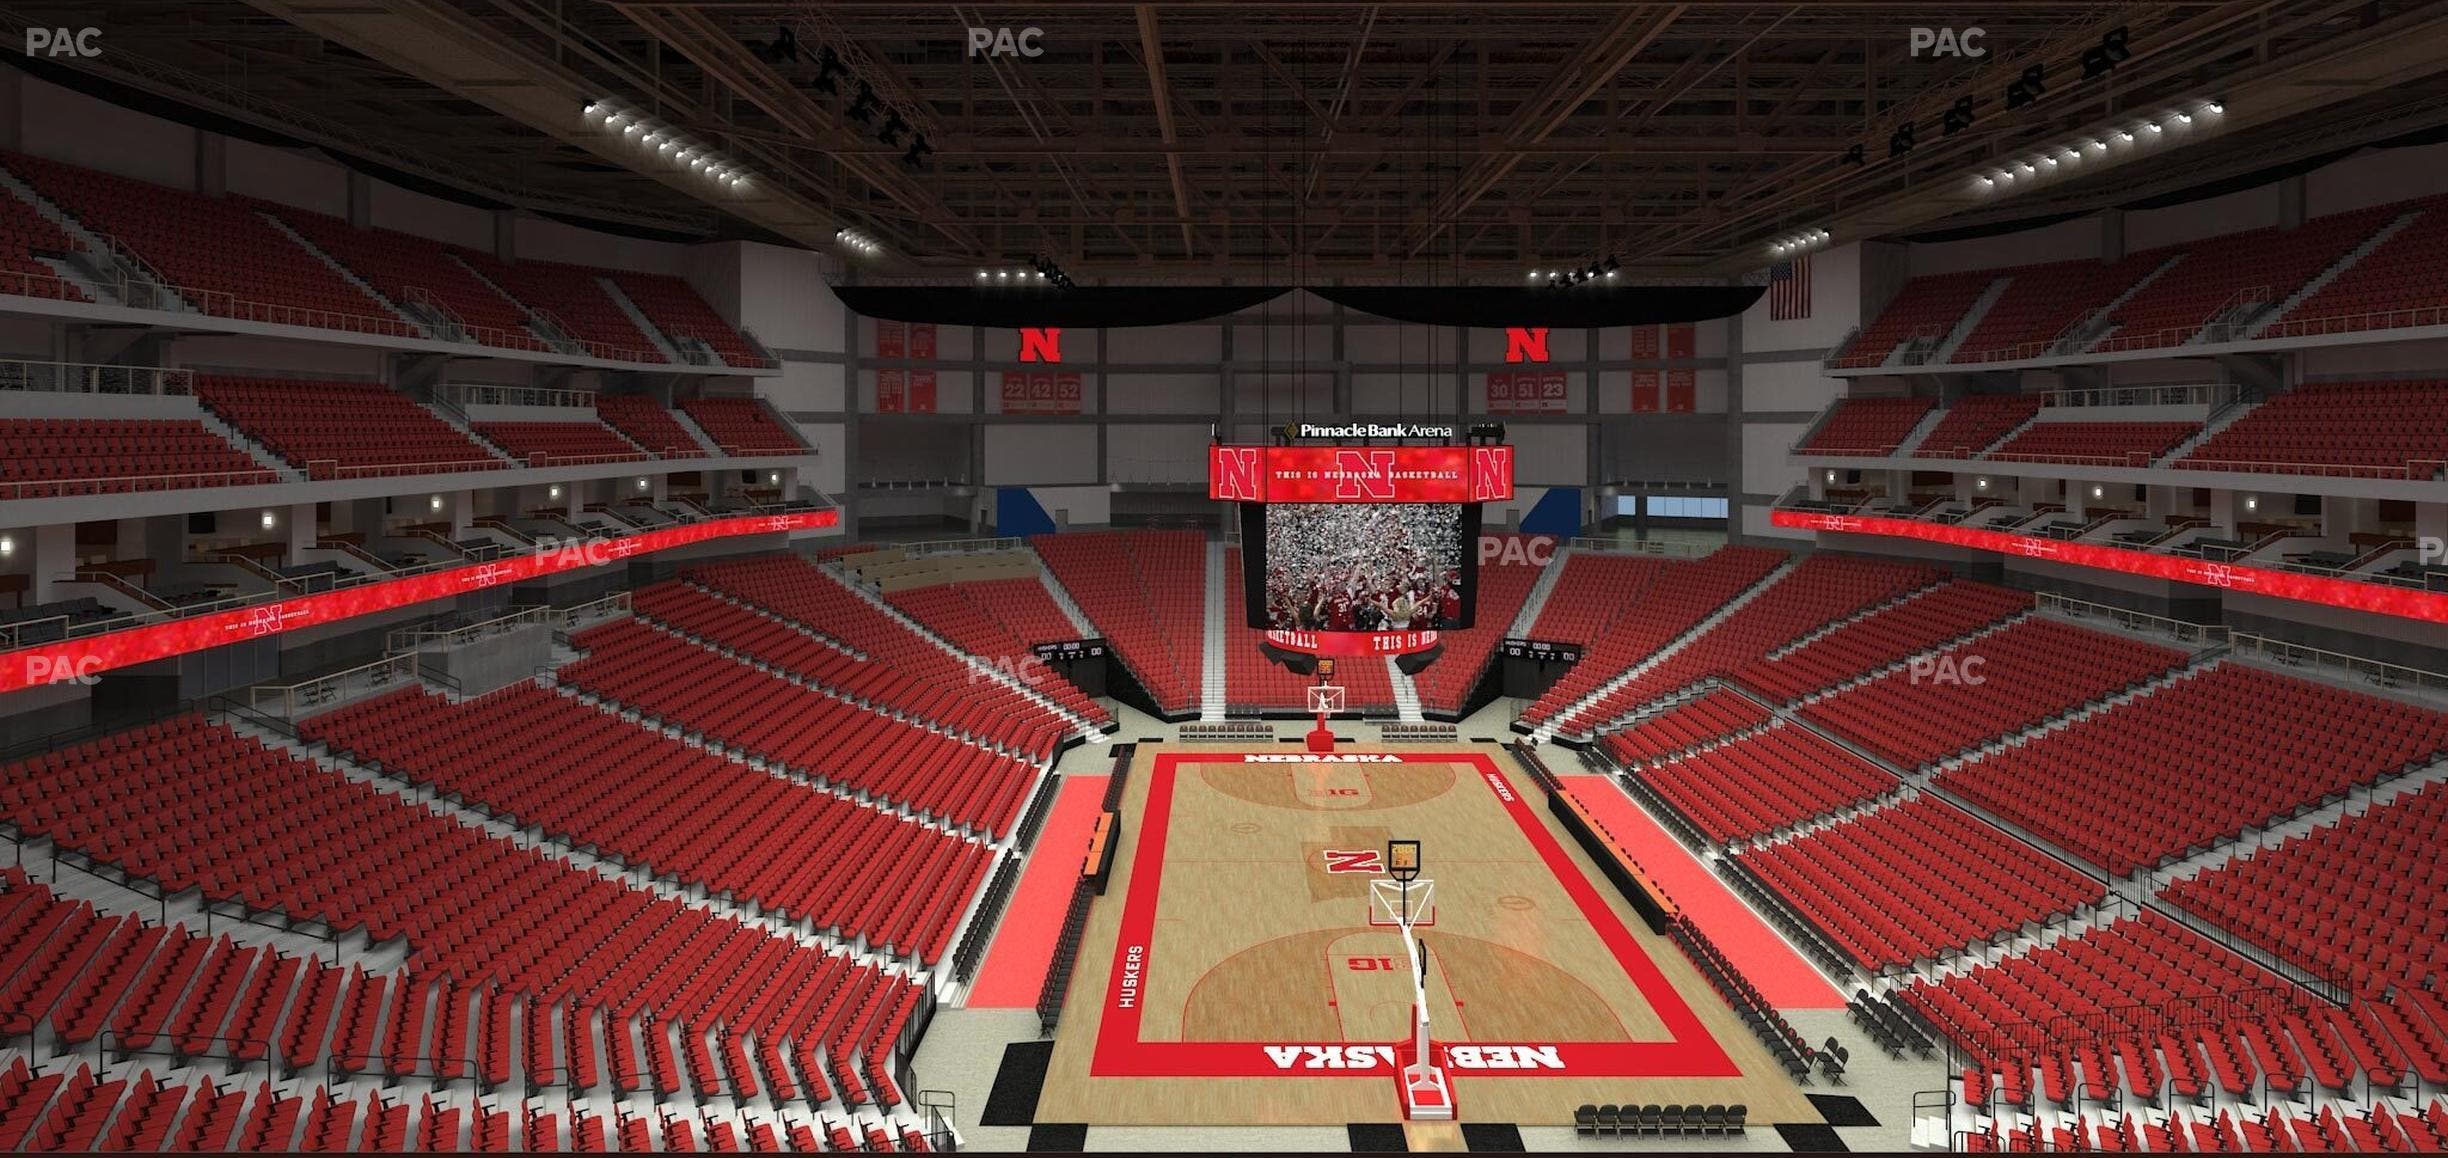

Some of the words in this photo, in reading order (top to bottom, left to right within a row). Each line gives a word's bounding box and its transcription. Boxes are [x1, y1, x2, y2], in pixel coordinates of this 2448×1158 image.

[1019, 327, 1061, 363] N
[1504, 327, 1549, 363] N
[1004, 383, 1025, 398] 22
[1031, 383, 1051, 398] 42
[1490, 383, 1508, 398] 30
[1543, 383, 1564, 398] 23
[1301, 423, 1366, 437] Pinnacle
[1368, 423, 1407, 437] Bank
[1408, 424, 1452, 437] Arena
[1219, 449, 1256, 500] N
[1275, 471, 1301, 479] THIS
[1307, 471, 1318, 479] IS
[1389, 471, 1458, 479] BASKETBALL
[1336, 451, 1395, 499] N
[1476, 449, 1506, 500] N
[254, 603, 283, 635] N
[1373, 635, 1402, 651] THIS
[1407, 633, 1417, 648] IS
[1244, 754, 1403, 763] NEBRASKA
[1118, 945, 1144, 1008] HUSKERS
[1263, 1045, 1566, 1069] NEBSKA
